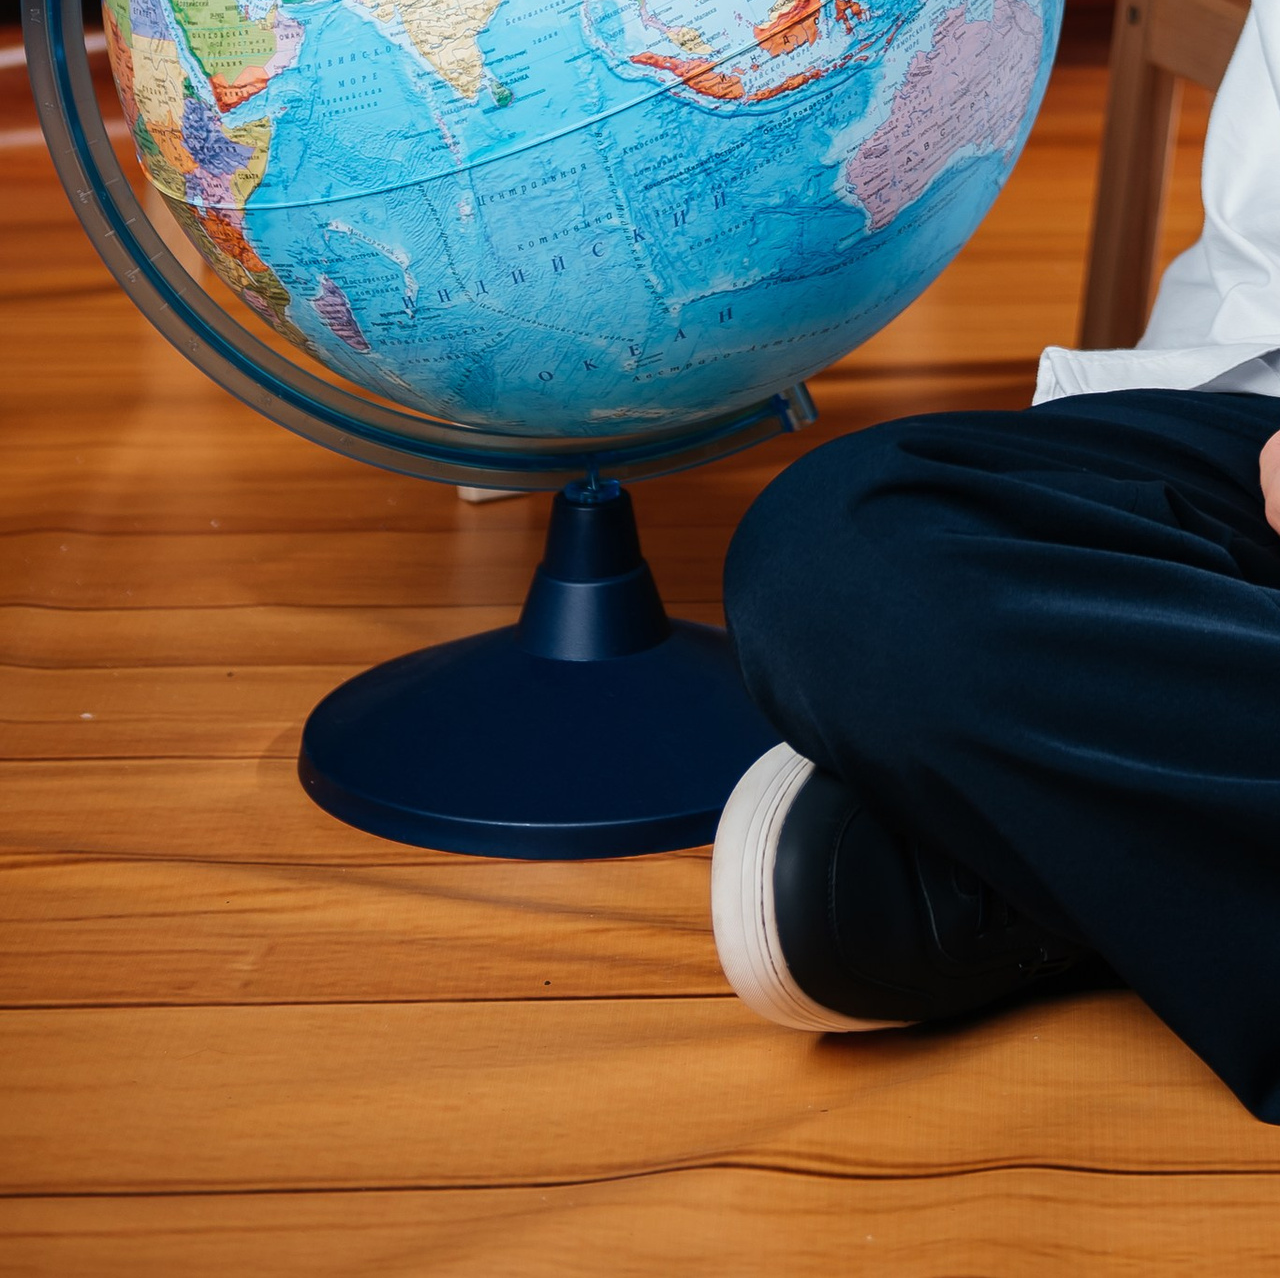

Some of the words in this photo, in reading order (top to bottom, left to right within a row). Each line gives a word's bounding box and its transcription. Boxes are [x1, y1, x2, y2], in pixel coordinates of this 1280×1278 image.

[279, 32, 301, 42] ОМАН
[763, 115, 792, 136] Остров
[475, 161, 588, 208] Центральная
[516, 211, 613, 252] котловина
[537, 306, 734, 384] ОКЕАН
